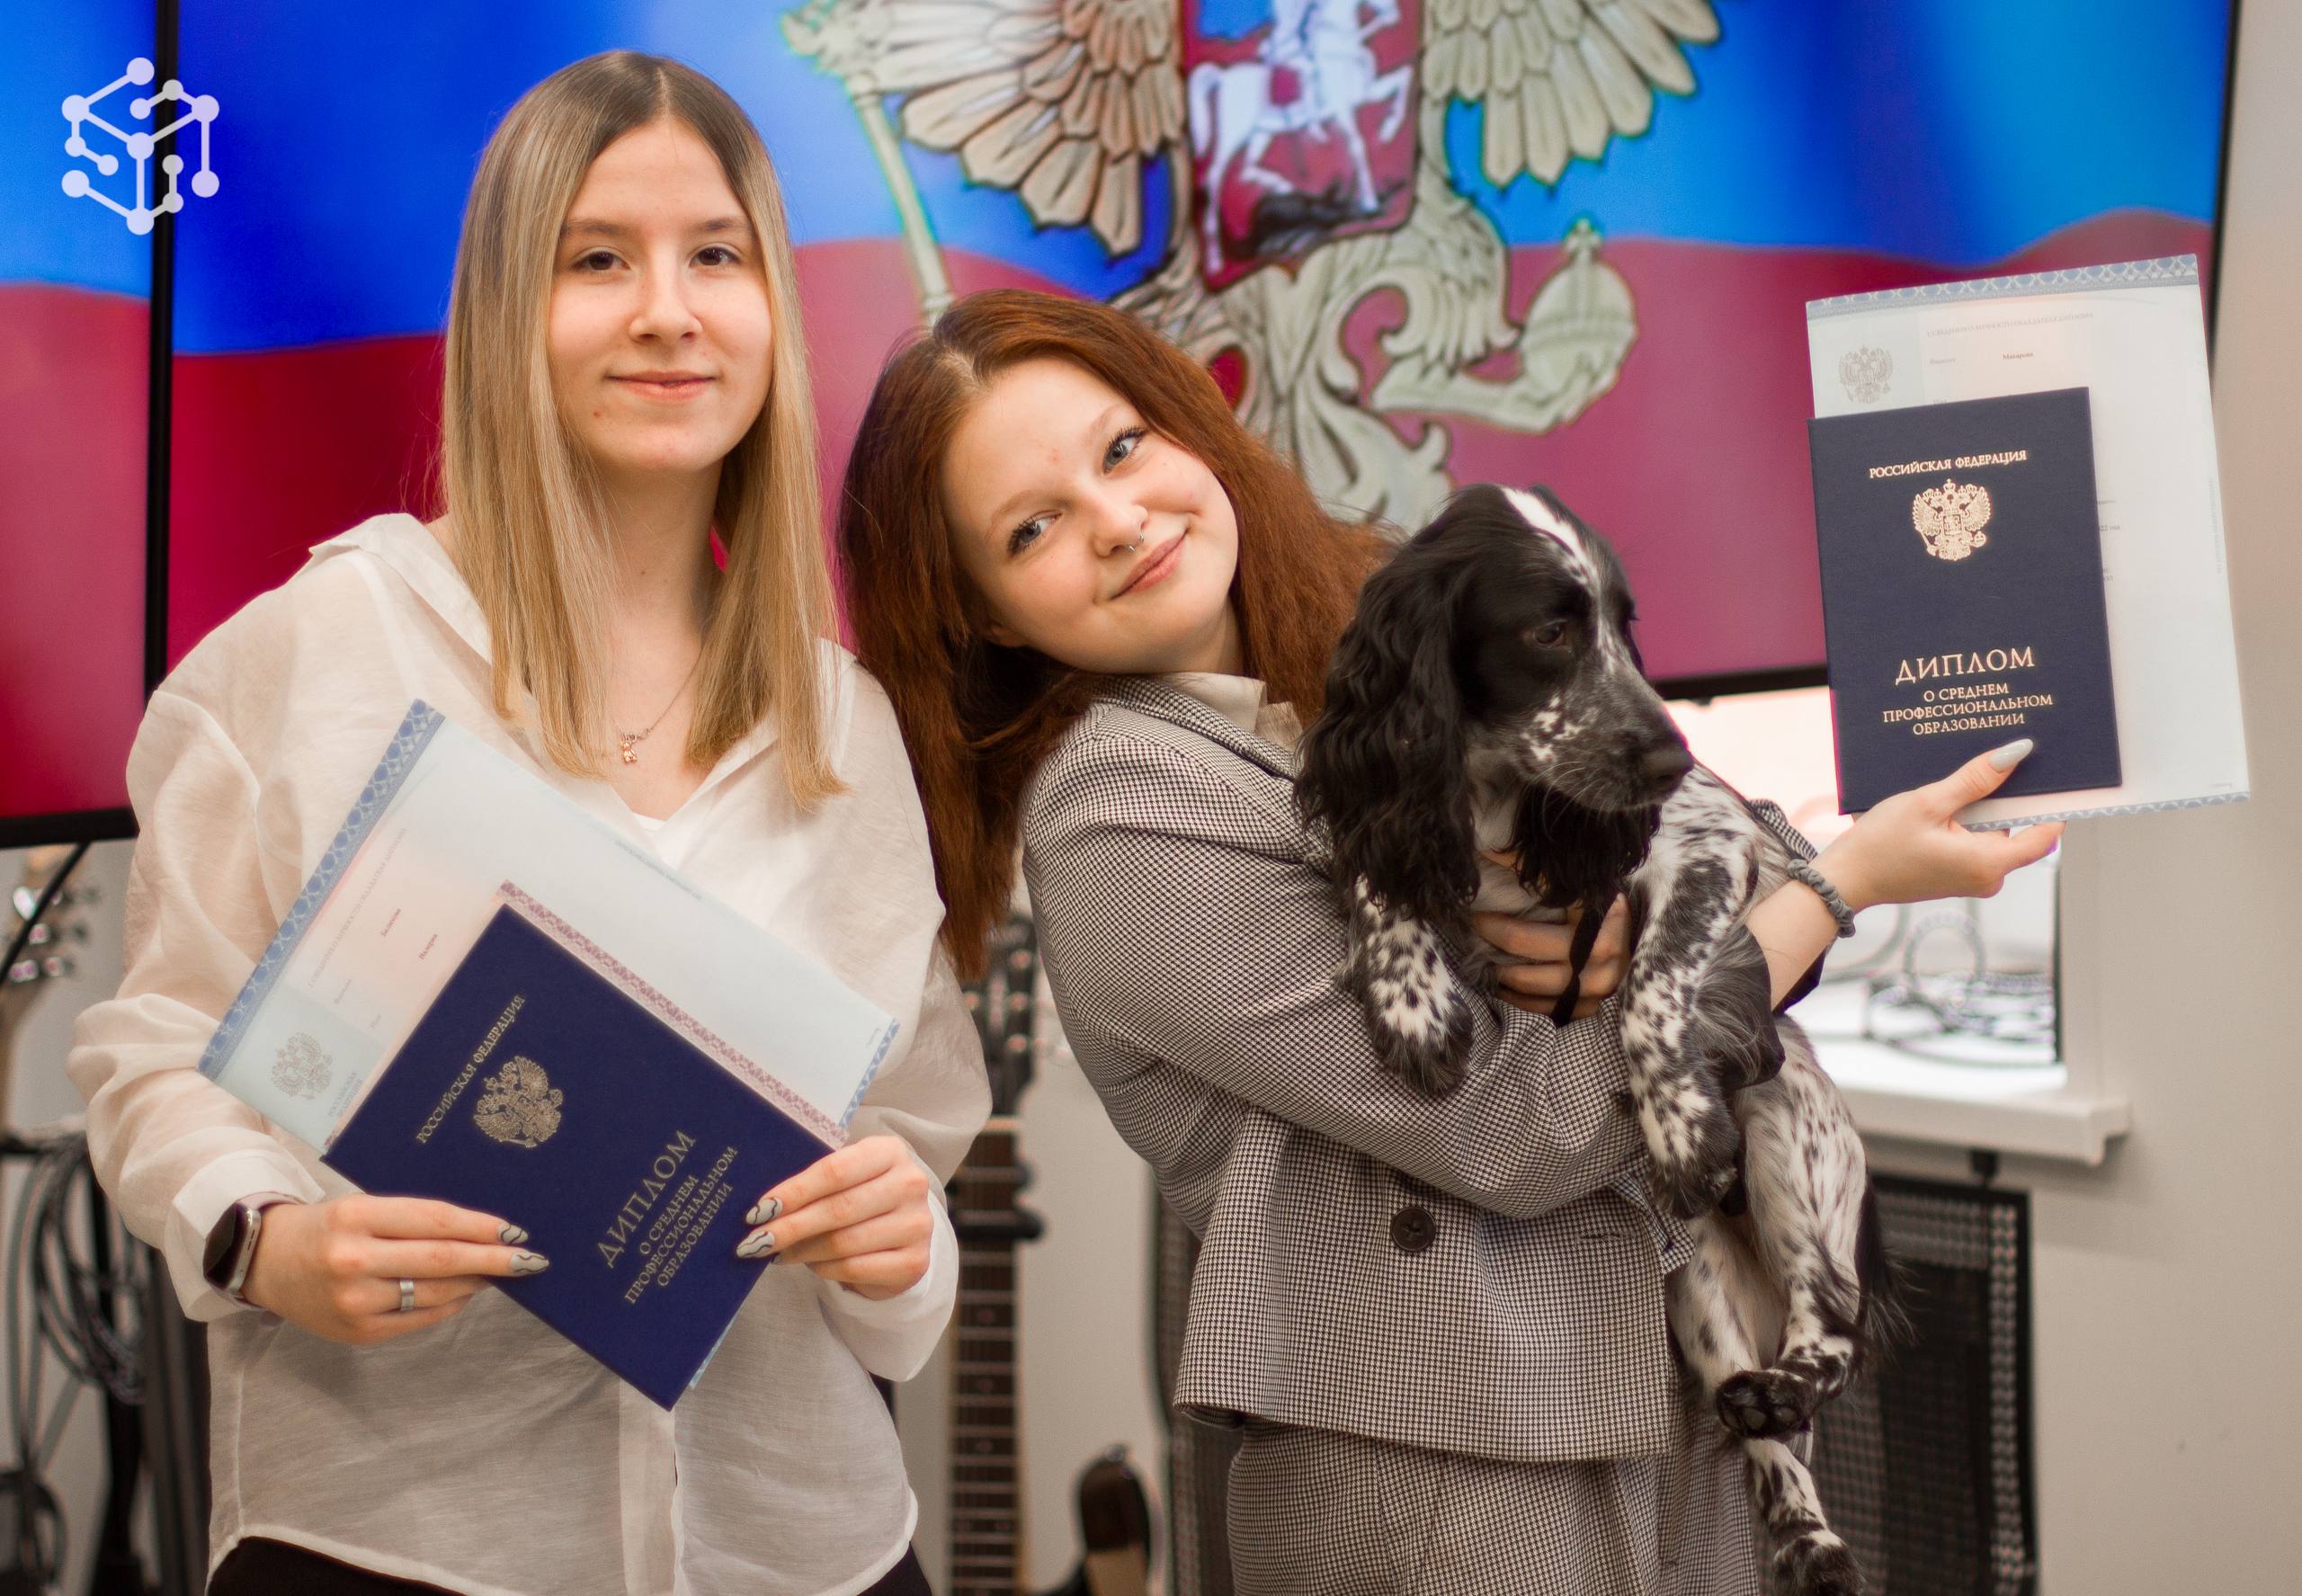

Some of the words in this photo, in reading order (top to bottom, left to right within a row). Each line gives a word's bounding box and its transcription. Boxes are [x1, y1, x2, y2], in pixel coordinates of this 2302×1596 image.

[1869, 459, 1952, 478] РОССИЙСКАЯ
[1954, 450, 2028, 468] ФЕДЕРАЦИЯ
[1895, 646, 2035, 686] ДИПЛОМ
[1923, 691, 1936, 702] О
[1939, 682, 2009, 700] СРЕДНЕМ
[1883, 694, 2054, 723] ПРОФЕССИОНАЛЬНОМ
[1913, 713, 2025, 735] ОБРАЗОВАНИИ
[415, 1062, 477, 1144] РОССИЙСКАЯ
[473, 994, 525, 1063] ФЕДЕРАЦИЯ
[598, 1130, 696, 1269] ДИПЛОМ
[624, 1146, 738, 1304] ПРОФЕССИОНАЛЬНОМ
[640, 1242, 651, 1255] О
[648, 1175, 699, 1242] СРЕДНЕМ
[657, 1183, 733, 1286] ОБРАЗОВАНИИ
